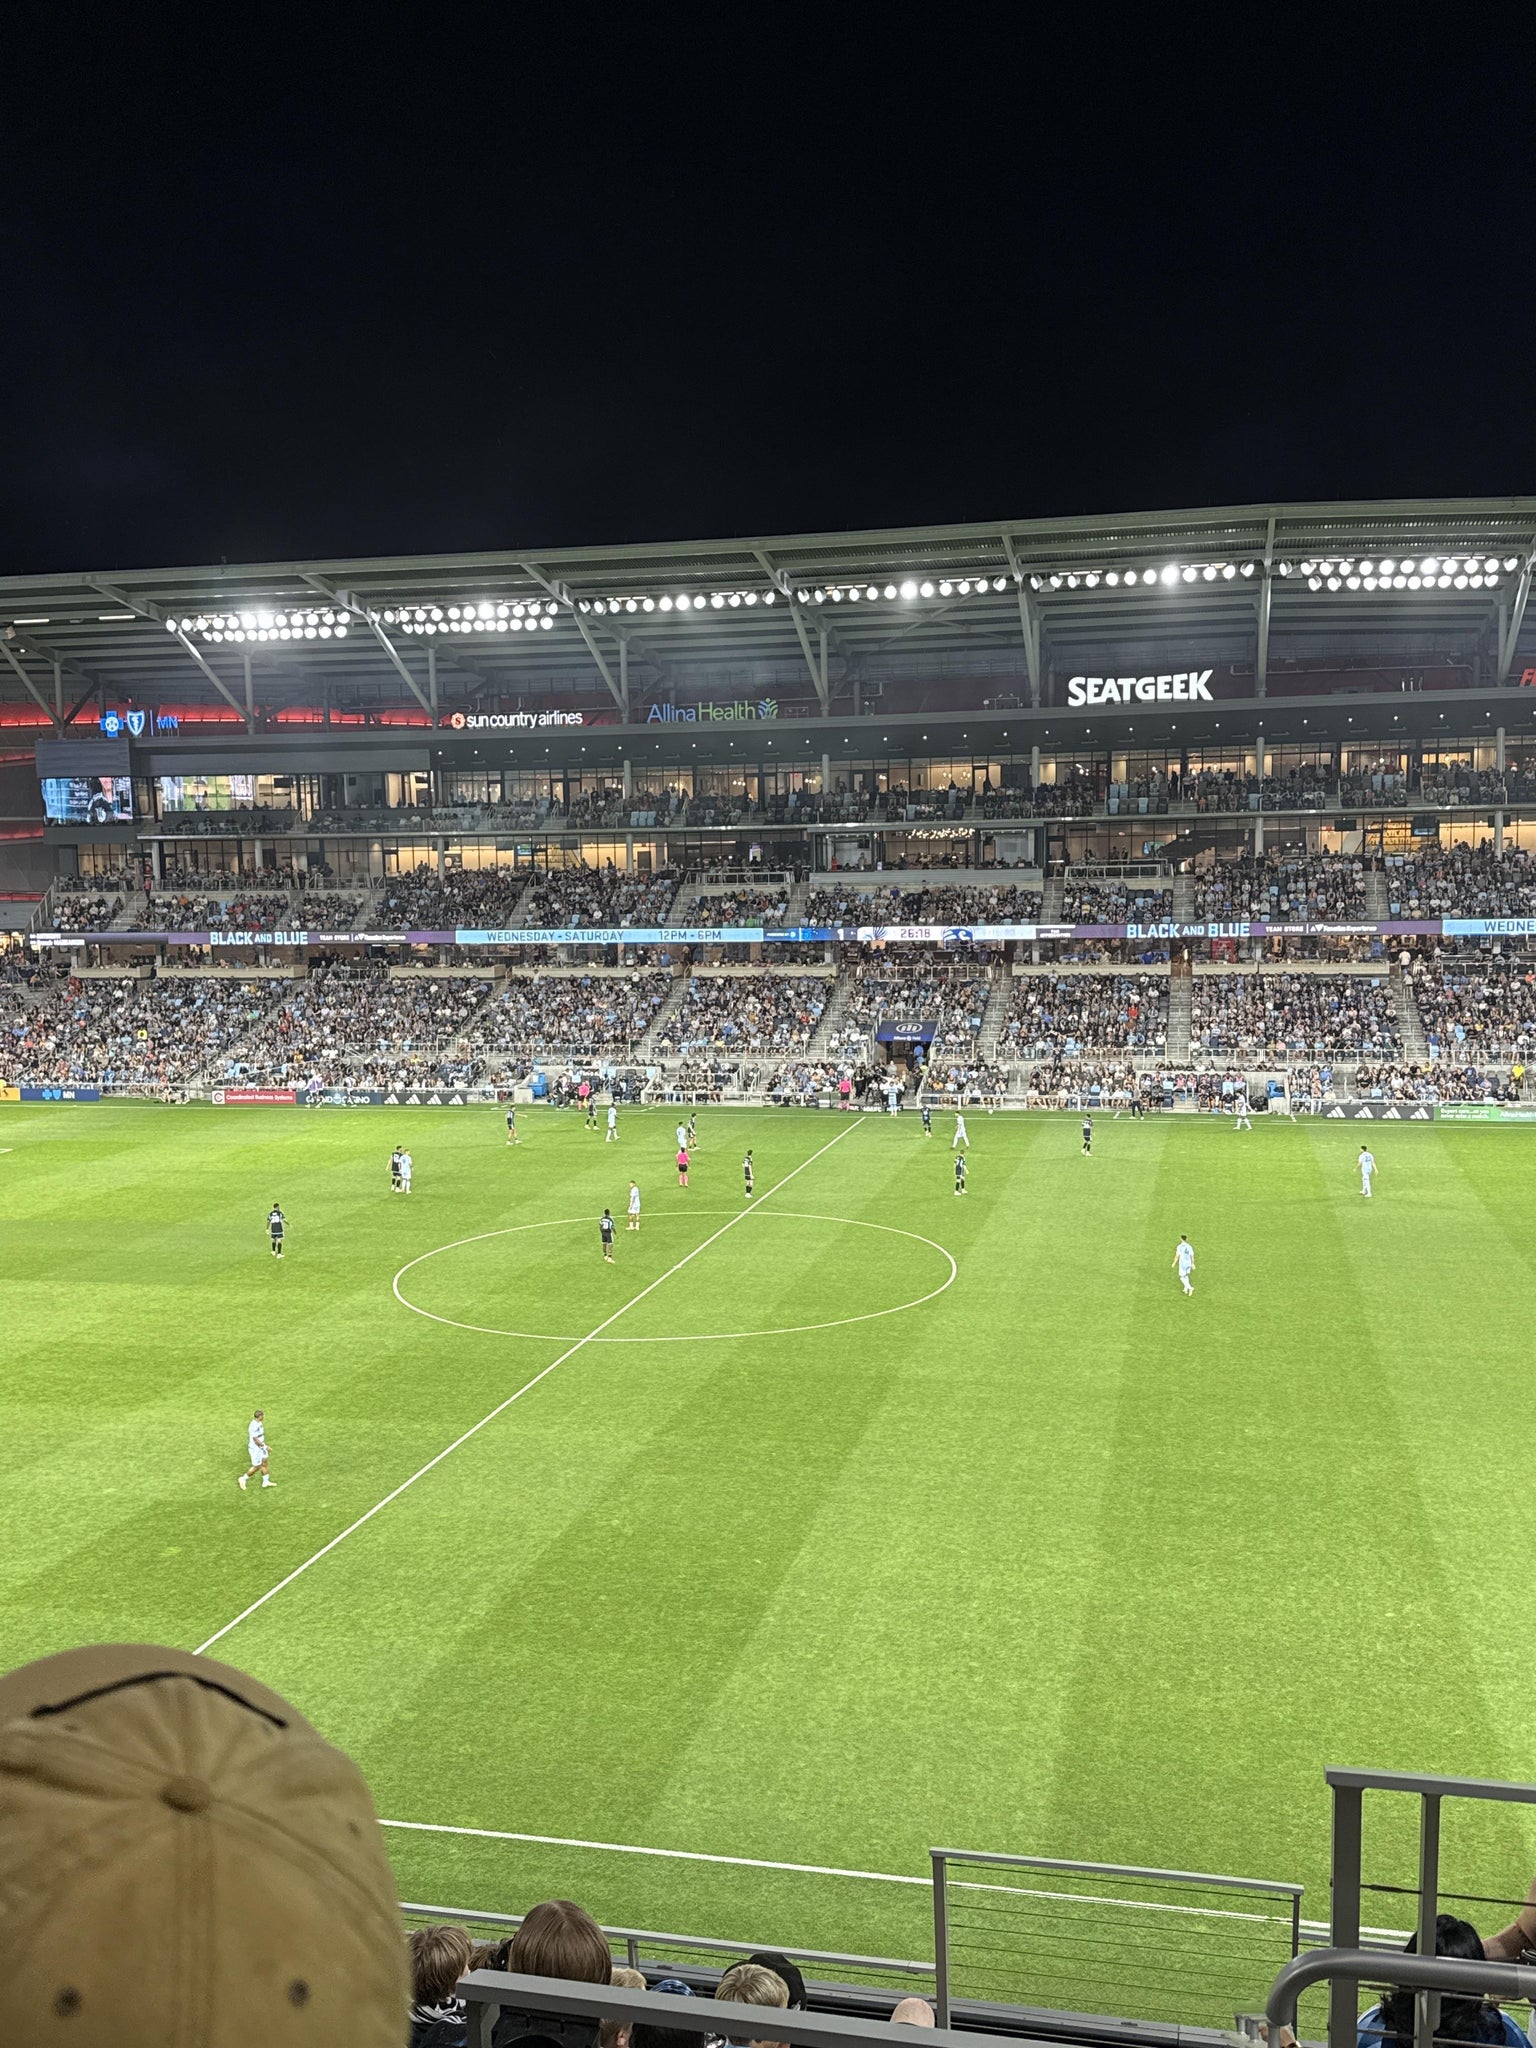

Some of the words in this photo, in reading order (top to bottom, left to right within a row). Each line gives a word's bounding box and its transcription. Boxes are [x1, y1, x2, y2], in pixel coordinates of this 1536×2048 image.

[1067, 669, 1214, 707] SEATGEEK
[647, 703, 696, 724] Allina
[698, 699, 756, 722] Health
[157, 715, 179, 729] MN
[467, 714, 489, 728] sun
[490, 711, 538, 729] country
[538, 710, 583, 726] airlines
[210, 931, 254, 945] BLACK
[254, 933, 272, 943] AND
[274, 931, 308, 945] BLUE
[487, 931, 555, 942] WEDNESDAY
[564, 930, 623, 941] SATURDAY
[658, 930, 687, 941] 12PM
[697, 930, 722, 941] 6PM
[837, 928, 844, 941] 1
[900, 928, 931, 939] 26:18
[1126, 924, 1181, 939] BLACK
[1182, 925, 1205, 936] AND
[1207, 923, 1251, 938] BLUE
[62, 1090, 76, 1099] MN
